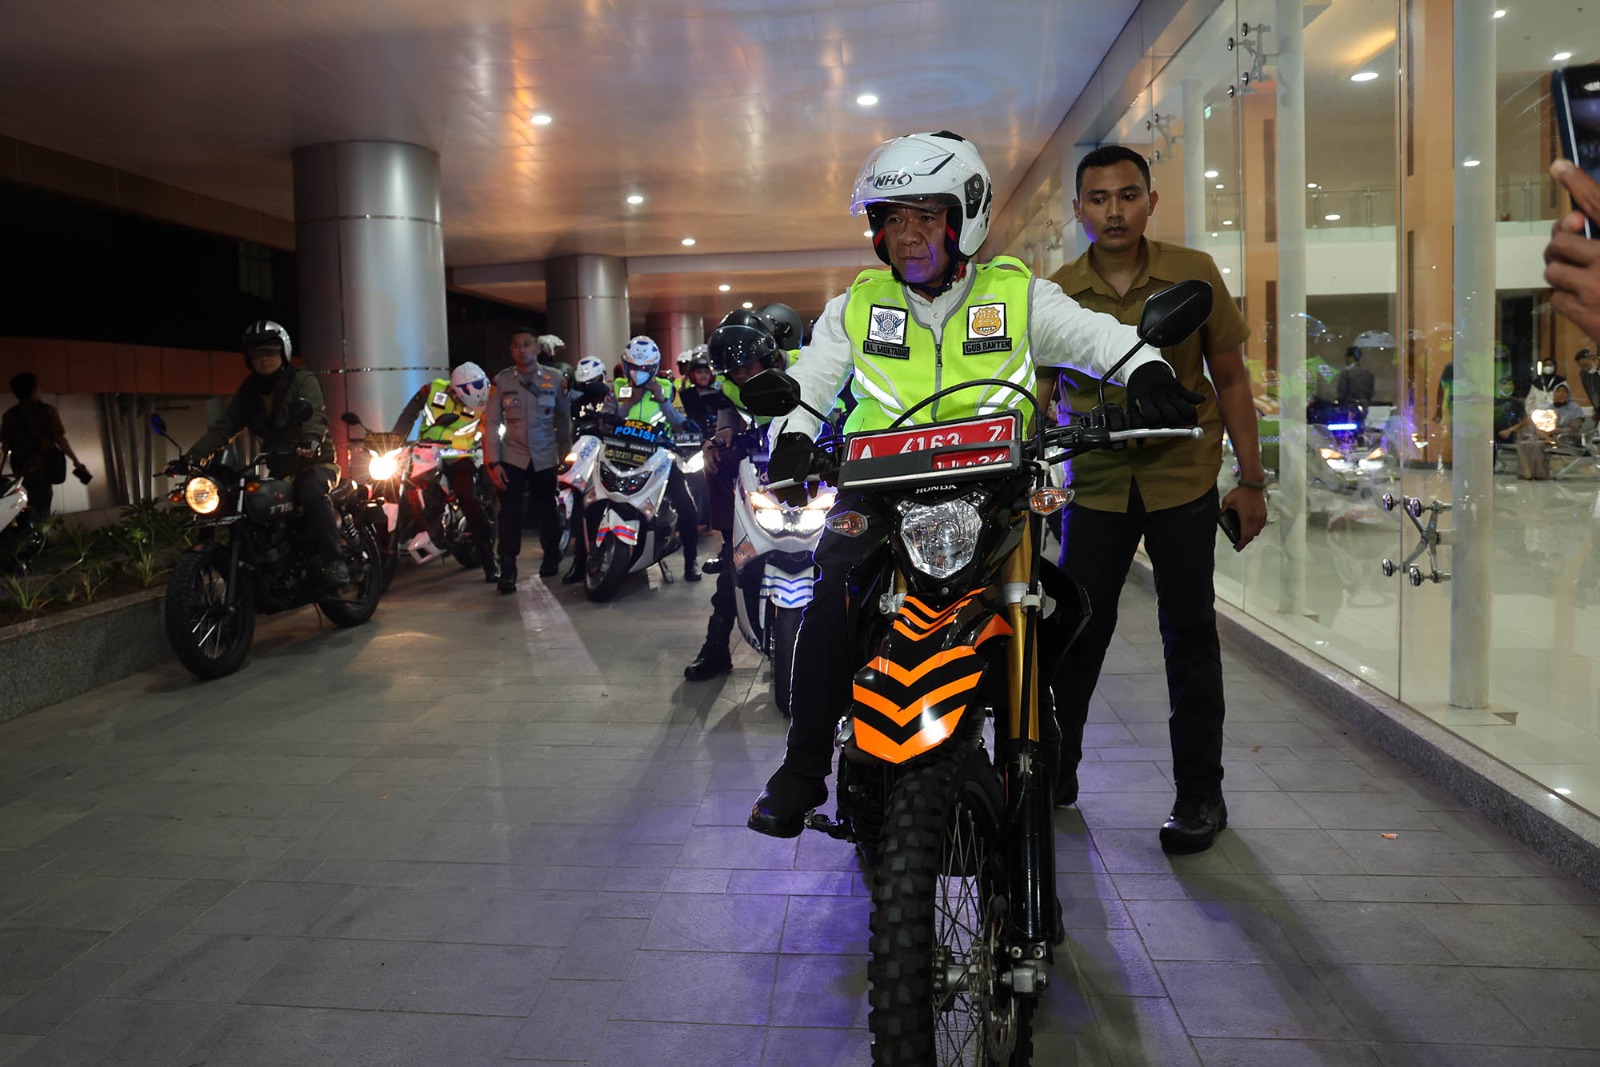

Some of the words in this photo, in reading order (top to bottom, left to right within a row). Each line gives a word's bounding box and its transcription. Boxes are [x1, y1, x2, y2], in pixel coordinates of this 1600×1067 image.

[875, 175, 908, 188] NHK
[866, 343, 876, 352] AL
[965, 343, 981, 353] GUB
[982, 340, 1010, 350] BANTEN
[614, 426, 656, 442] POLISI
[860, 444, 872, 460] A
[915, 484, 957, 494] HONDA
